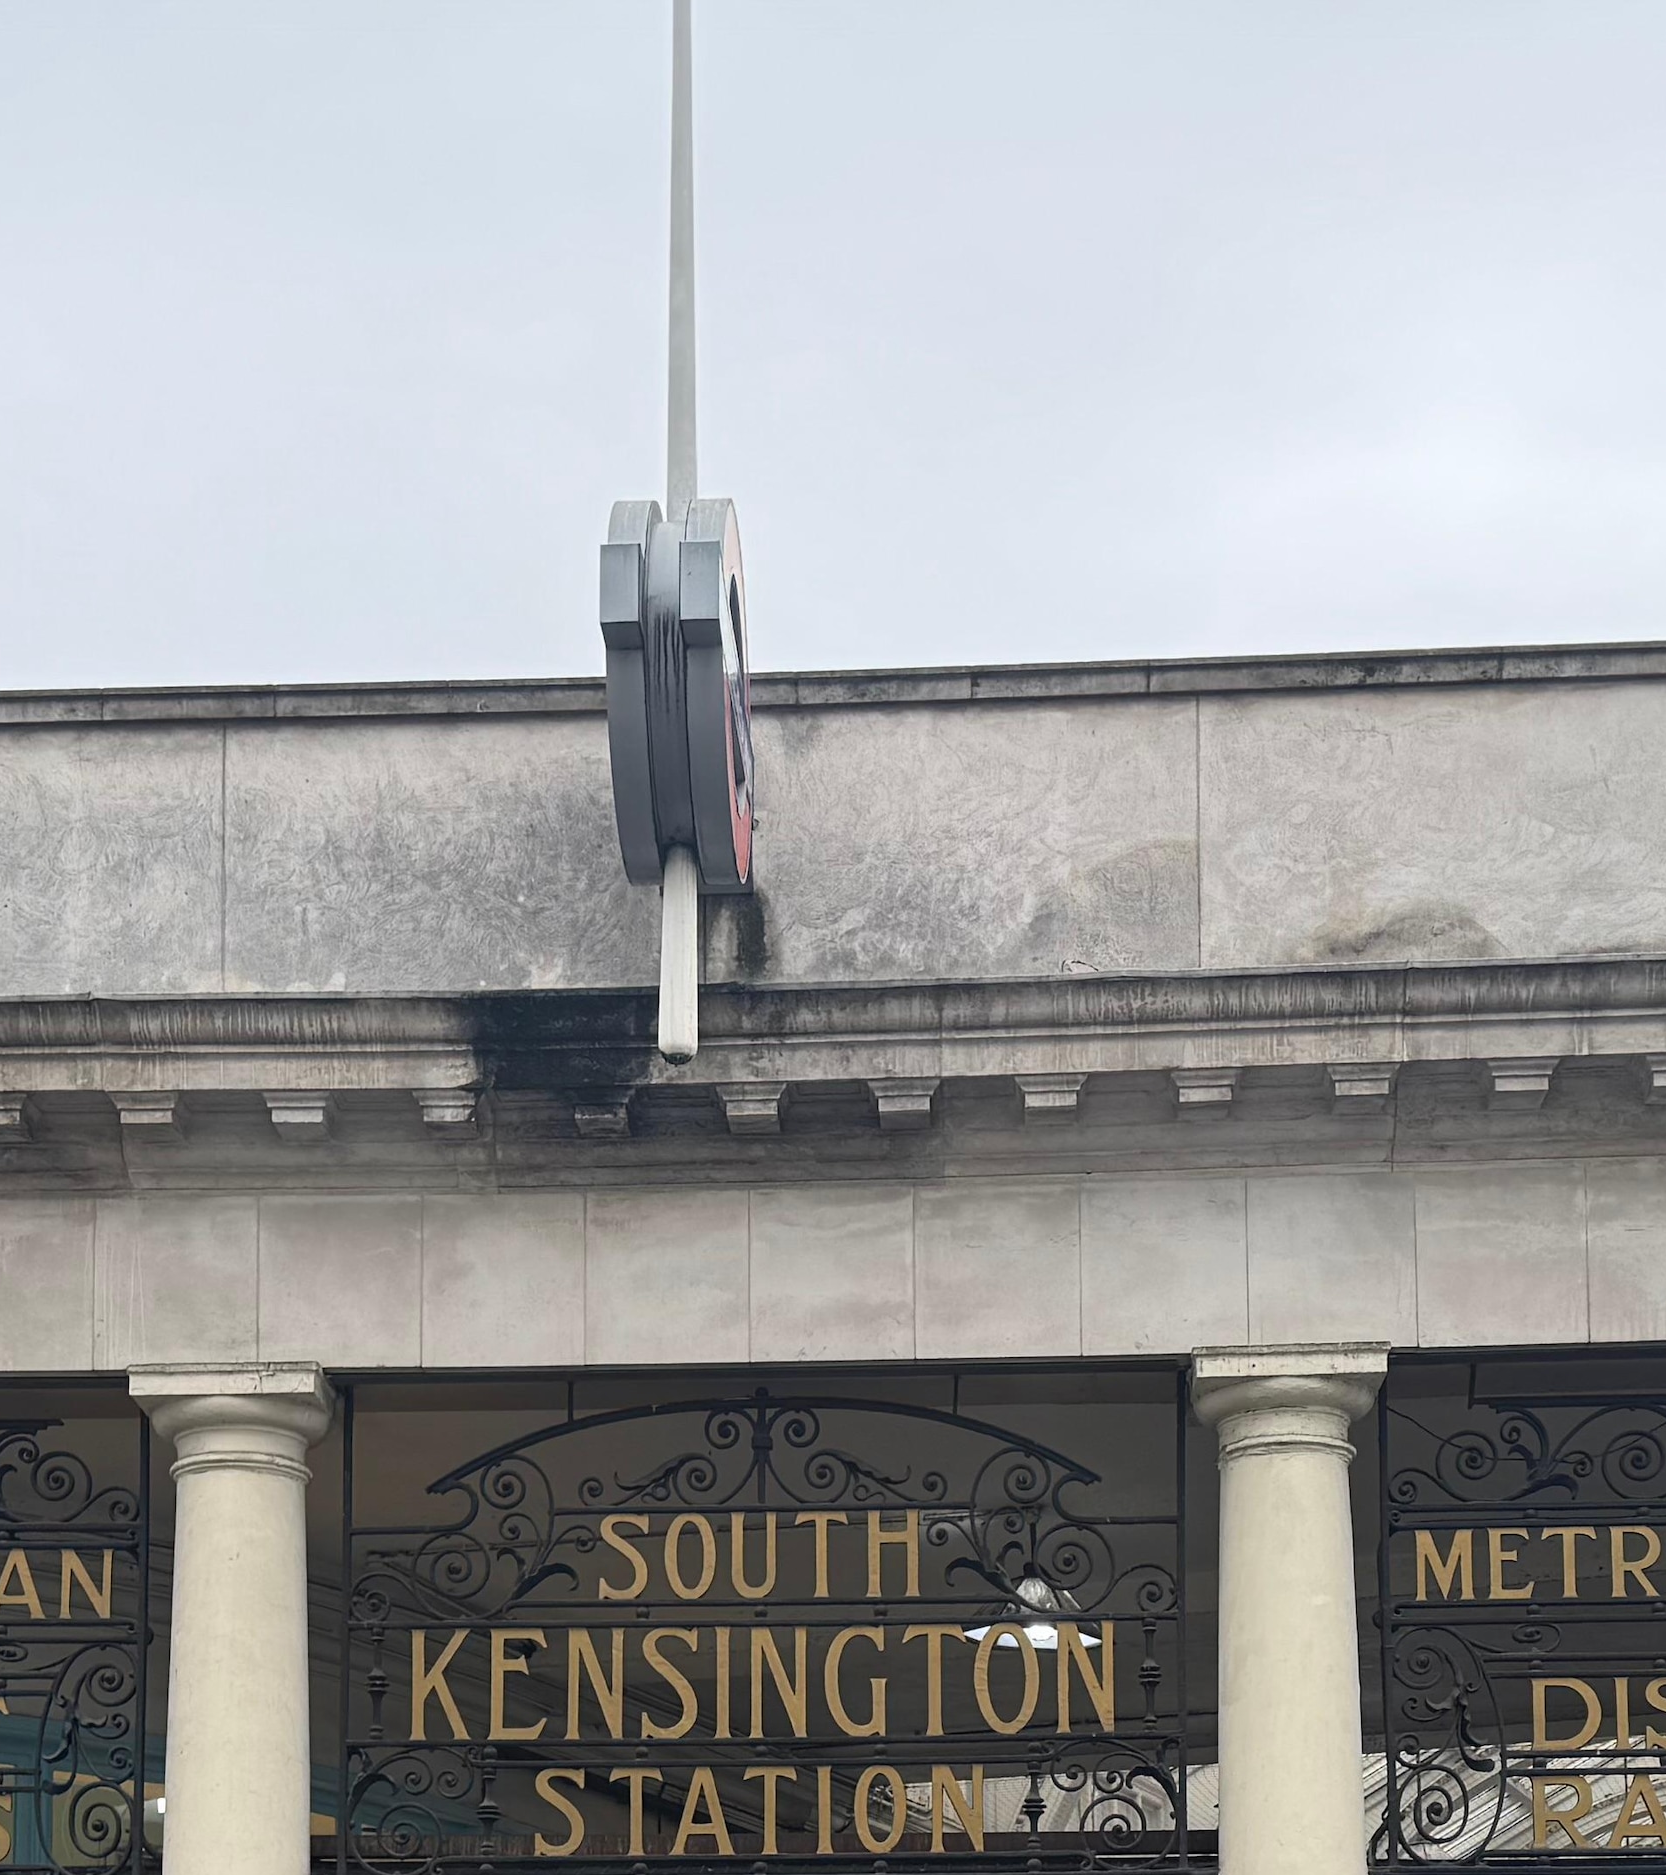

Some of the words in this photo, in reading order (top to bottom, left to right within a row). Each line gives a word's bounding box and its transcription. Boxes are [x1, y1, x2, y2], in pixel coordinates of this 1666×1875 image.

[598, 1508, 922, 1600] SOUTH
[408, 1620, 1116, 1741] KENSINGTON
[534, 1763, 985, 1857] STATION
